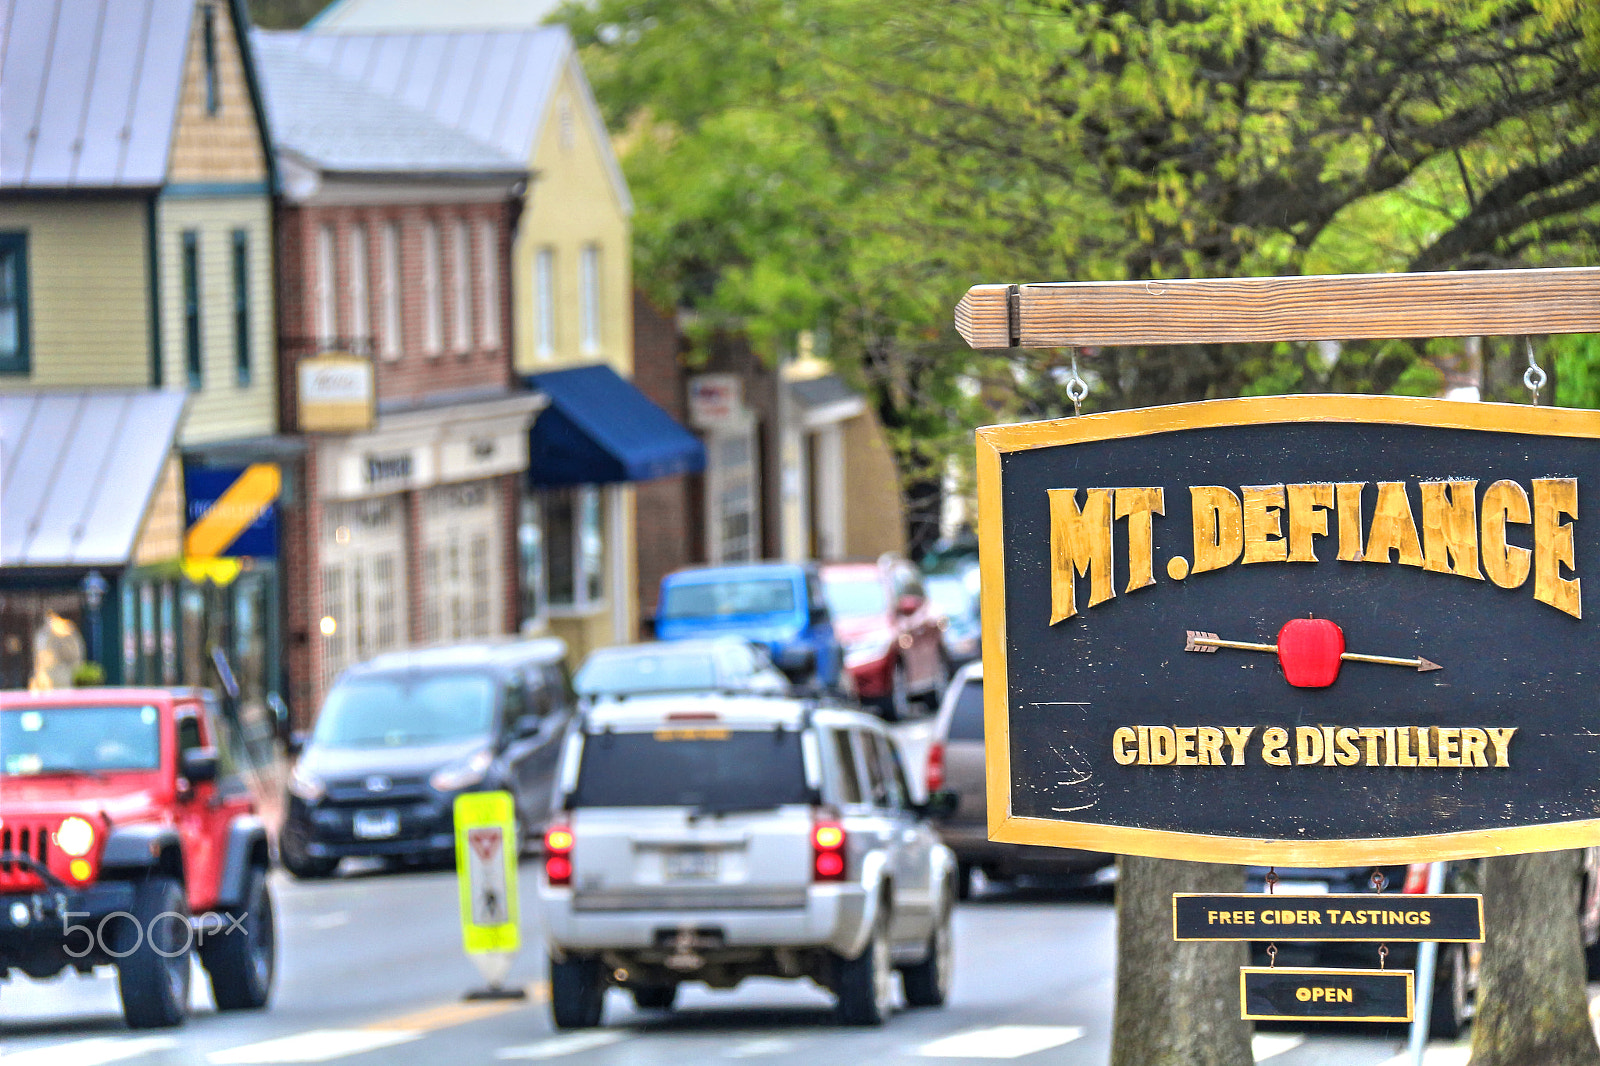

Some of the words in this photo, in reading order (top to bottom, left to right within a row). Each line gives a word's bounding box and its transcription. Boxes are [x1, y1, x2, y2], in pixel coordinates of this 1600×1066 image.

[1112, 724, 1255, 767] CIDERY
[1261, 726, 1292, 767] &
[1296, 724, 1519, 768] DISTILLERY
[1207, 910, 1256, 925] FREE
[1260, 910, 1322, 925] CIDER
[1326, 909, 1432, 926] TASTINGS
[1295, 987, 1354, 1003] OPEN
